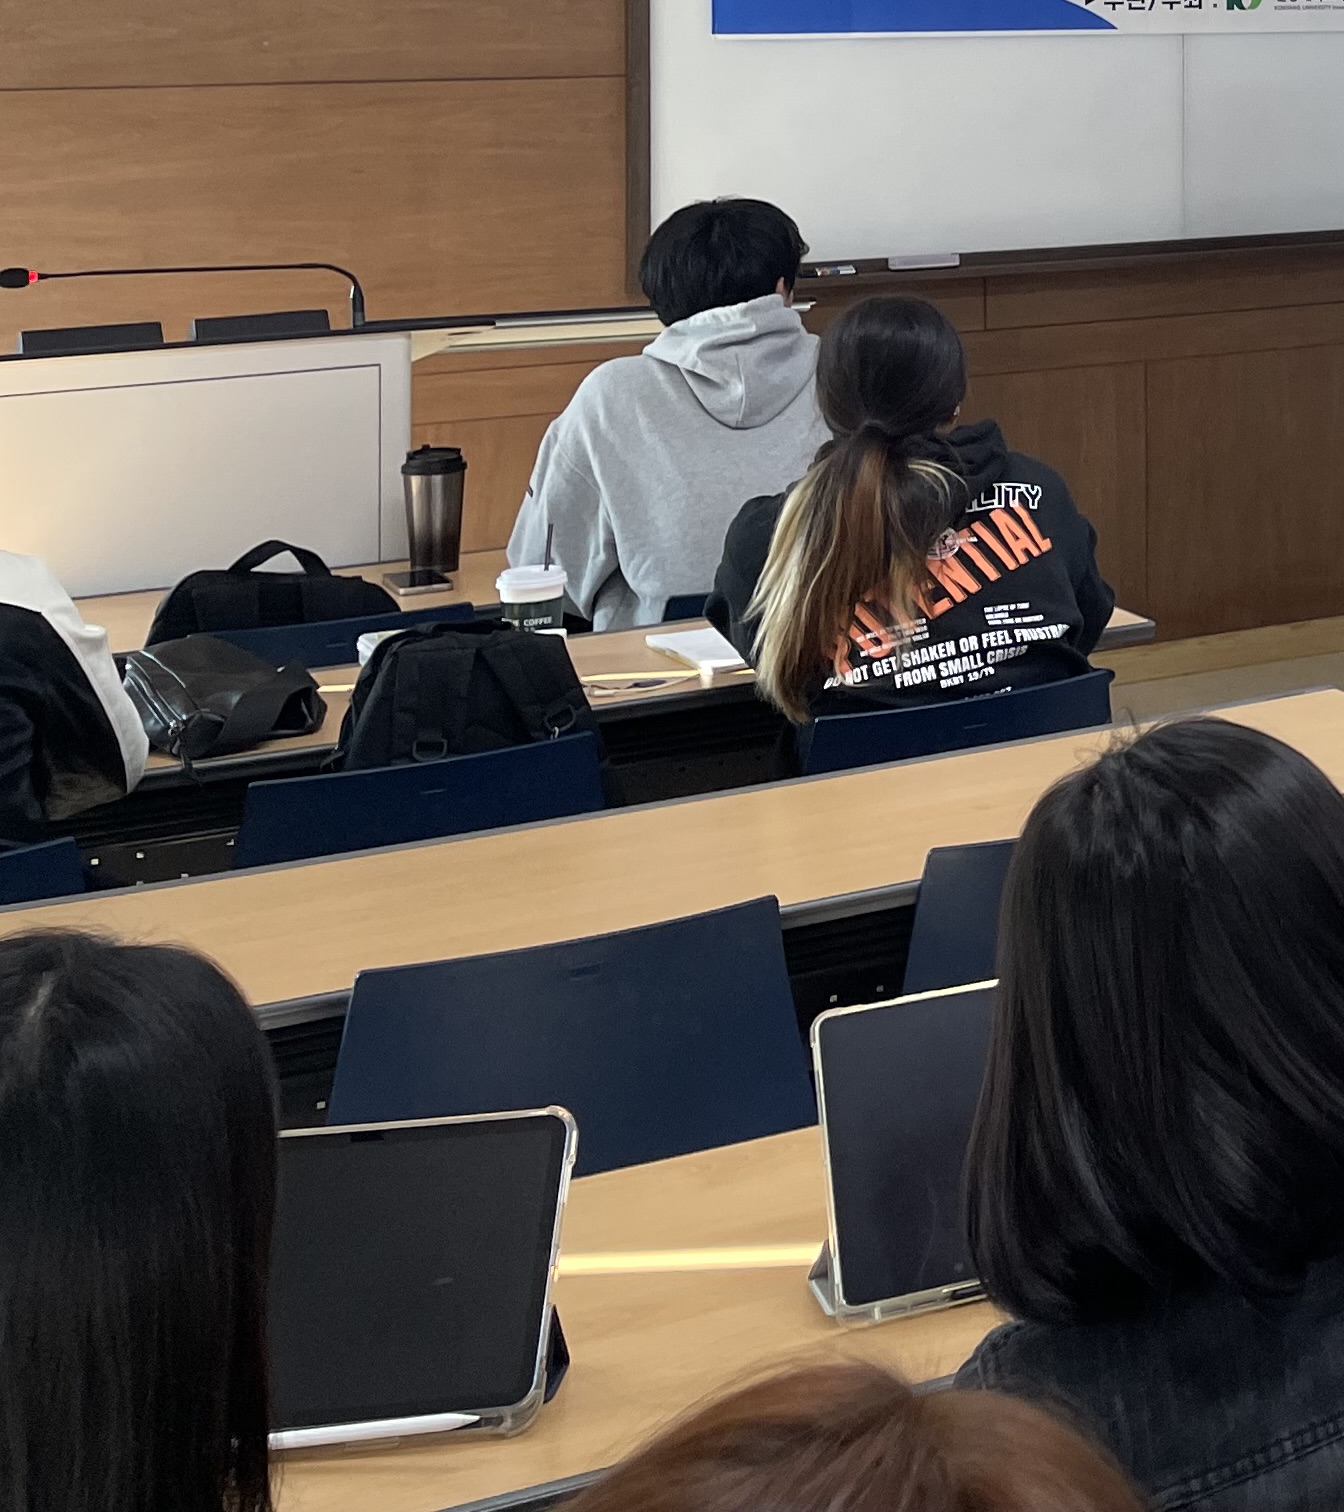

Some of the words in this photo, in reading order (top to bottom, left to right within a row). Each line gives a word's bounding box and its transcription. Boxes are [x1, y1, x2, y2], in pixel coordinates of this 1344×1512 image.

[872, 656, 898, 677] GET
[902, 642, 956, 668] SHAKEN
[959, 635, 979, 652] OR
[982, 629, 1013, 648] FEEL
[894, 665, 937, 689] FROM
[938, 654, 985, 678] SMALL
[987, 644, 1029, 664] CRISIS
